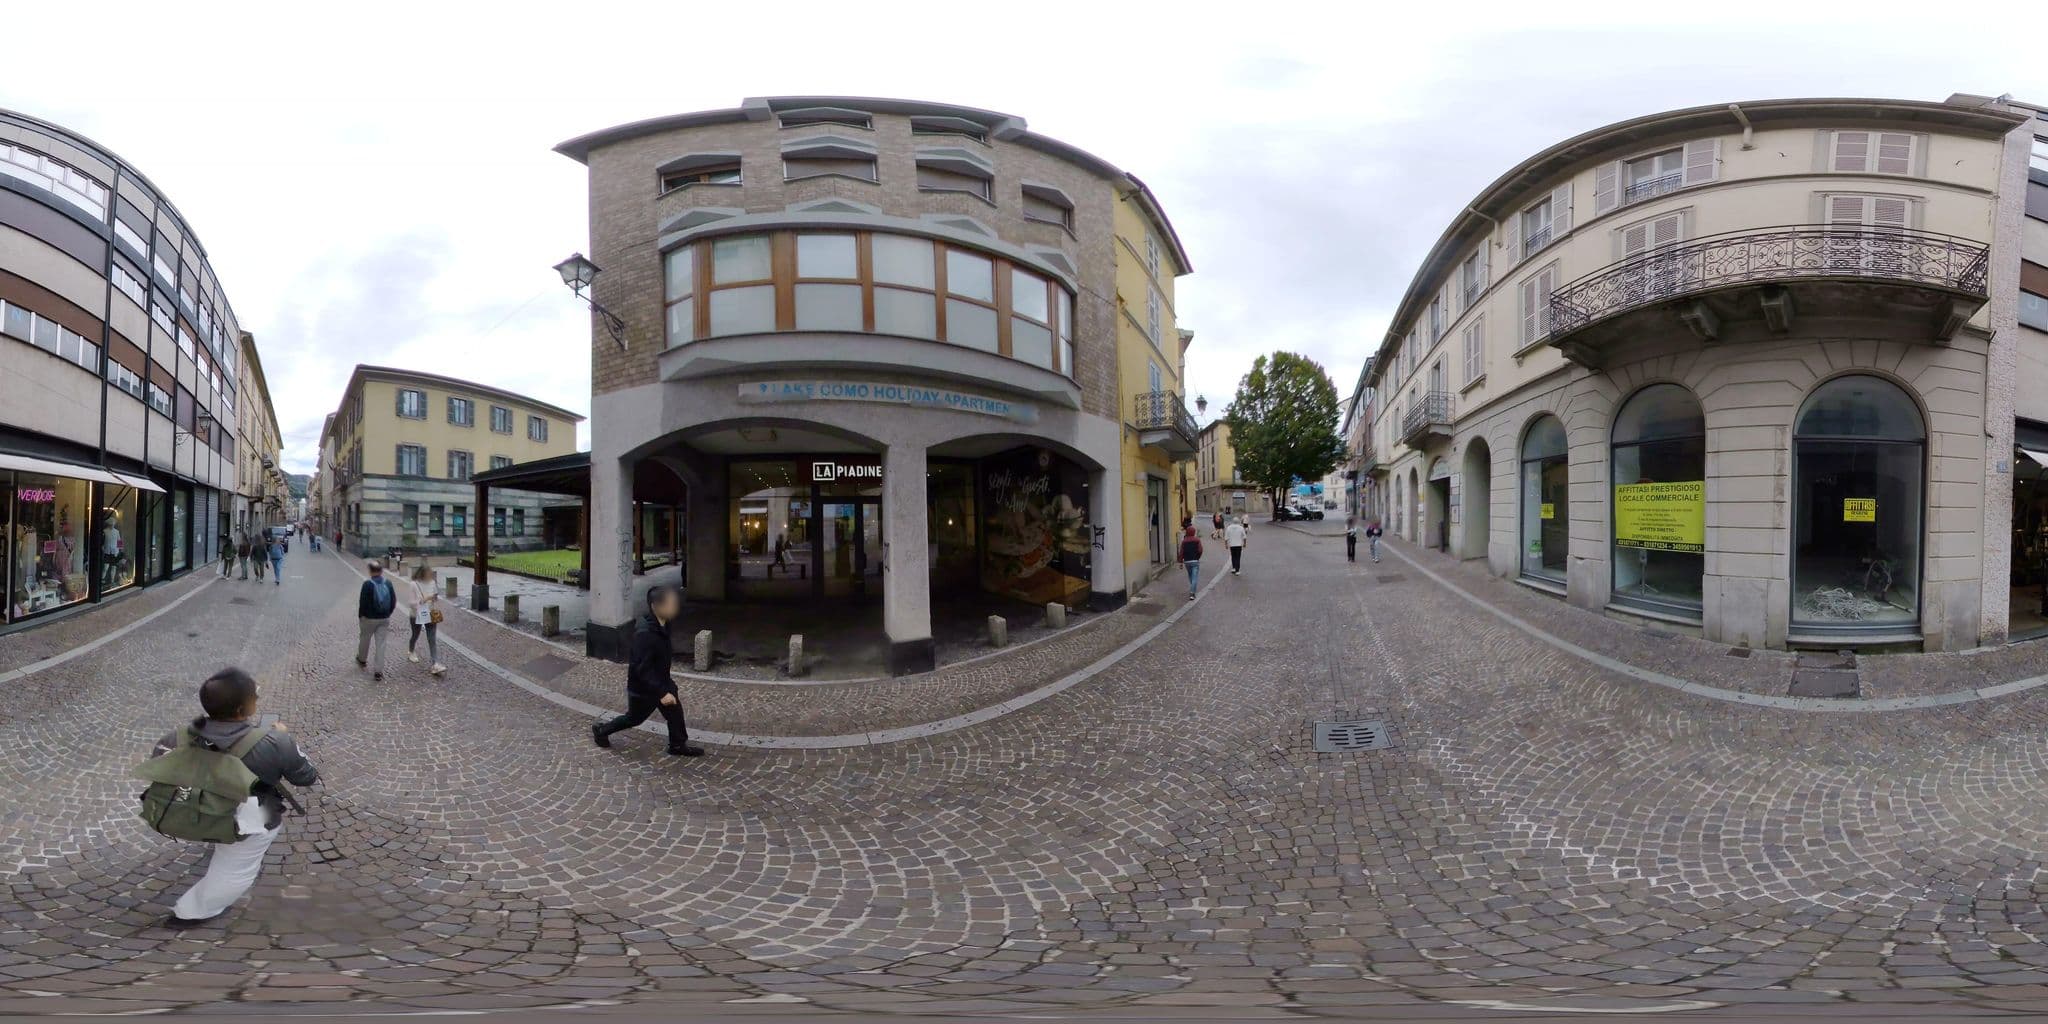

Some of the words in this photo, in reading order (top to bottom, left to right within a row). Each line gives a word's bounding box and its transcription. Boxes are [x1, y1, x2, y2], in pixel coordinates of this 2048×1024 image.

[820, 384, 869, 398] COMO
[873, 386, 939, 402] HOLIDAY
[816, 465, 832, 477] LA
[1618, 486, 1650, 494] AFFITTASI
[1651, 484, 1700, 493] PRESTIGIOSO
[1645, 493, 1700, 502] COMMERCIALE
